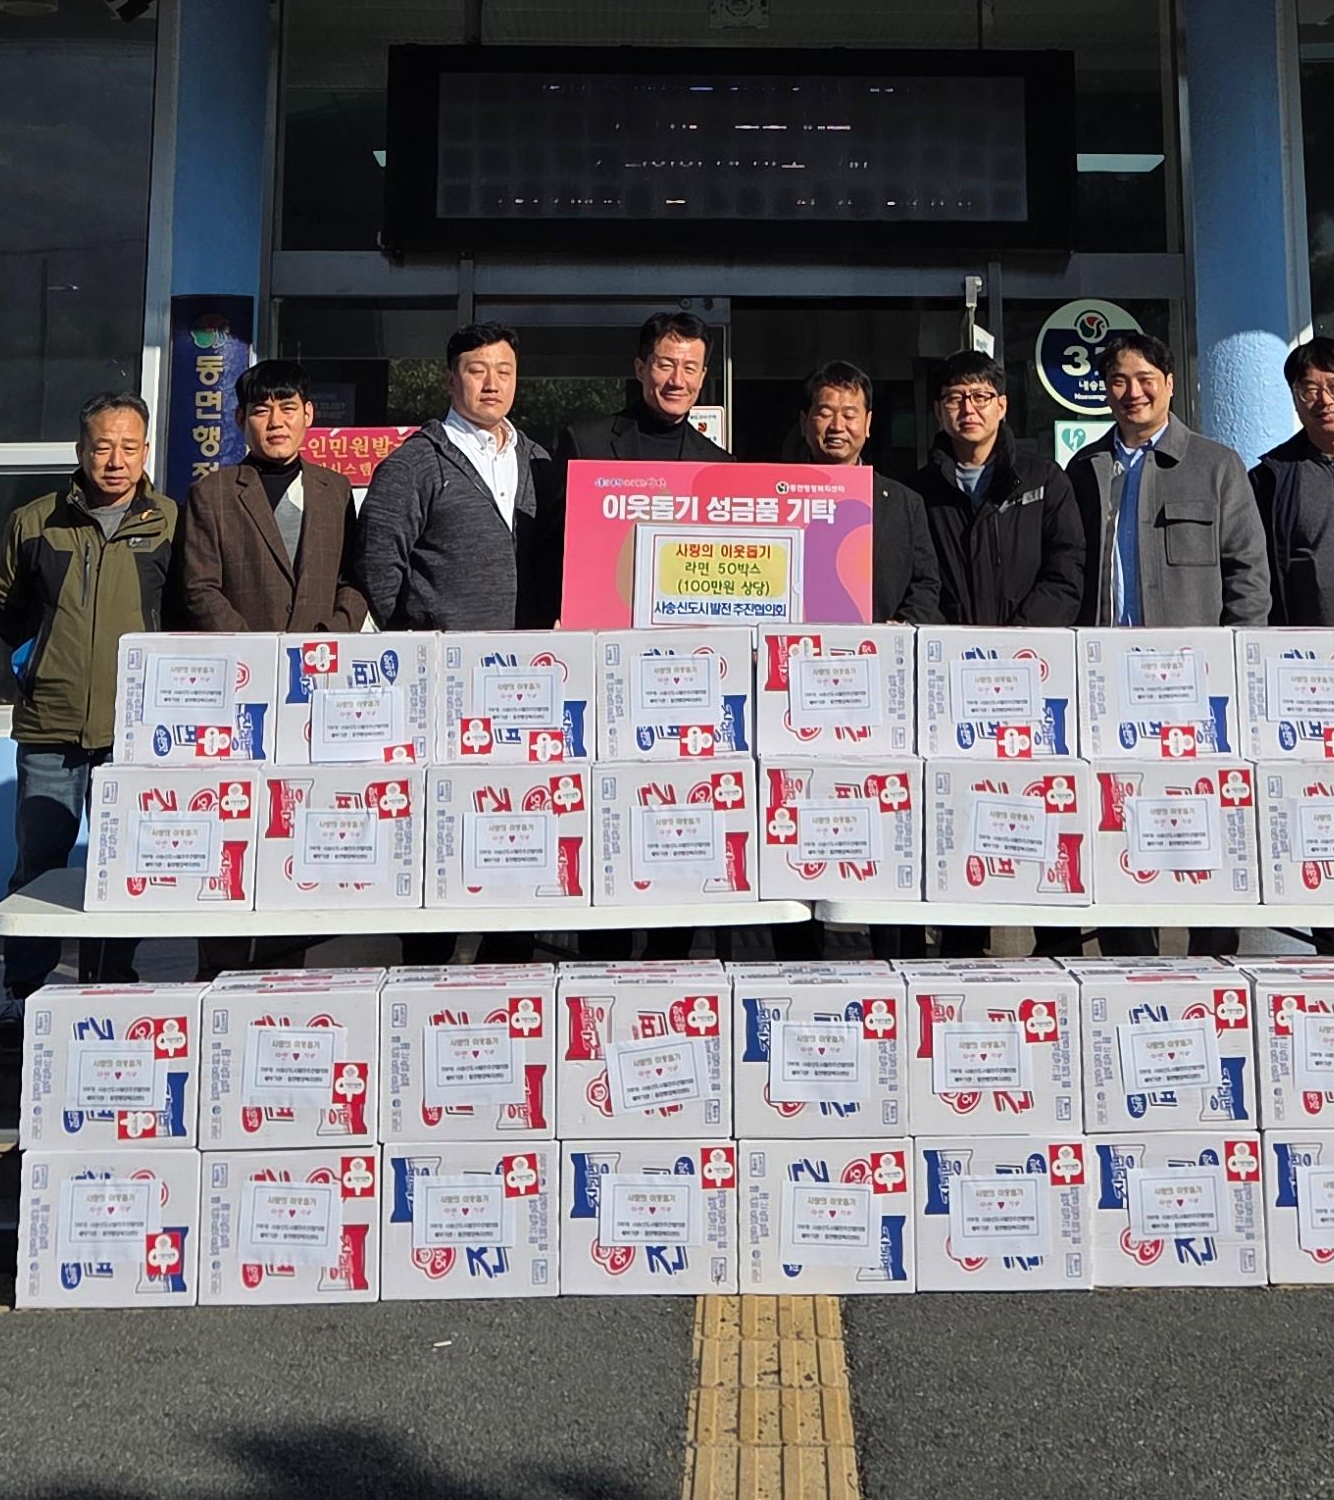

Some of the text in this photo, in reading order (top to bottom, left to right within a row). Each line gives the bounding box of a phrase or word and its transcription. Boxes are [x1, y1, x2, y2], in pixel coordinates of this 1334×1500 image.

[603, 494, 837, 524] 이웃돕기 성금품 기탁
[676, 544, 771, 560] 사랑의 이웃돕기
[685, 562, 762, 577] 라면 50박스
[677, 579, 770, 596] (100만원 상당)
